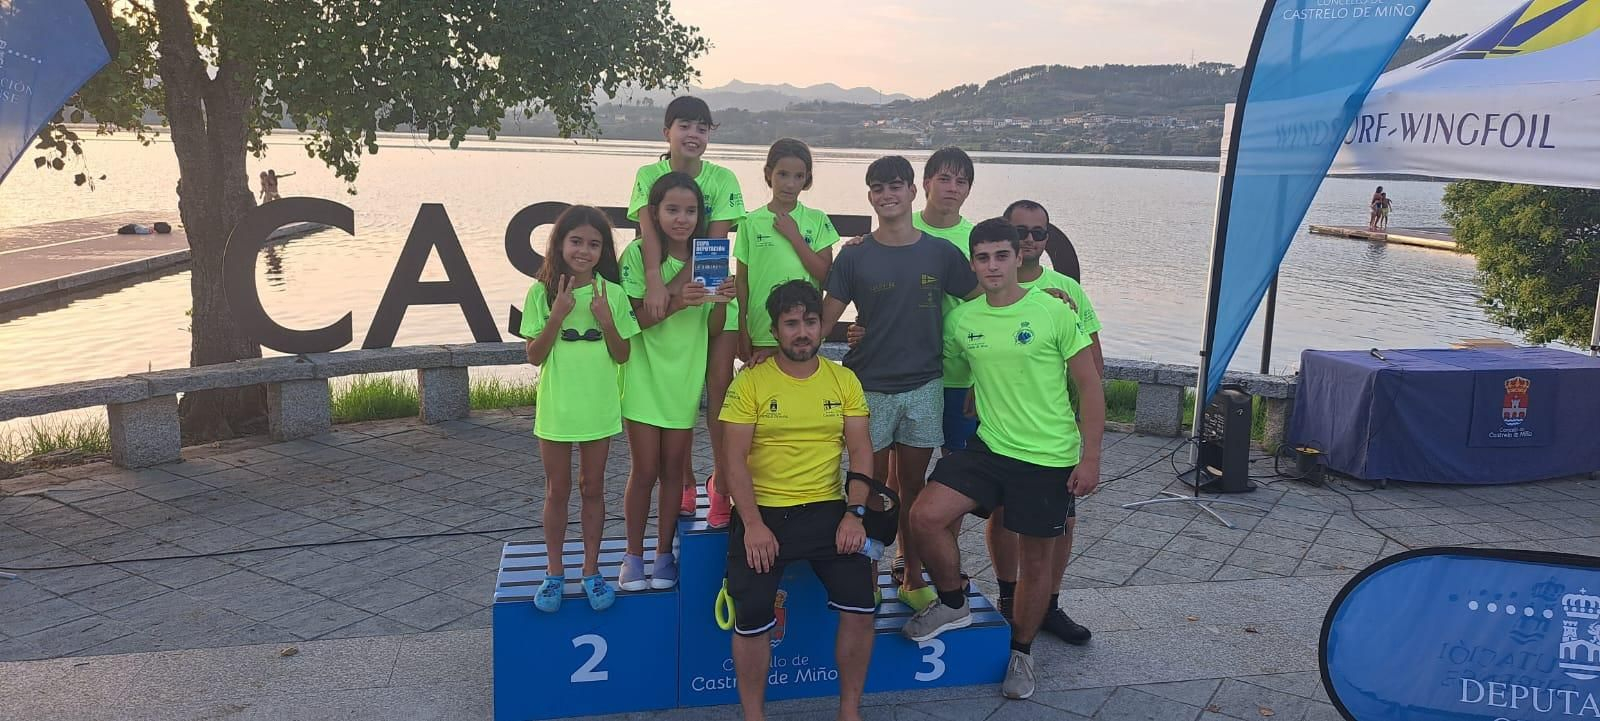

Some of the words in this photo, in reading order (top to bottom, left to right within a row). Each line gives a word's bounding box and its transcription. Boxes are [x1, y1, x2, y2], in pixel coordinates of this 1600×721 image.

[1283, 8, 1348, 20] CASTRELO
[1352, 7, 1371, 18] DE
[1375, 4, 1416, 17] MIÑO
[570, 634, 609, 683] 2
[791, 653, 809, 666] de
[914, 638, 946, 682] 3
[768, 671, 788, 685] de
[794, 666, 838, 683] Miño
